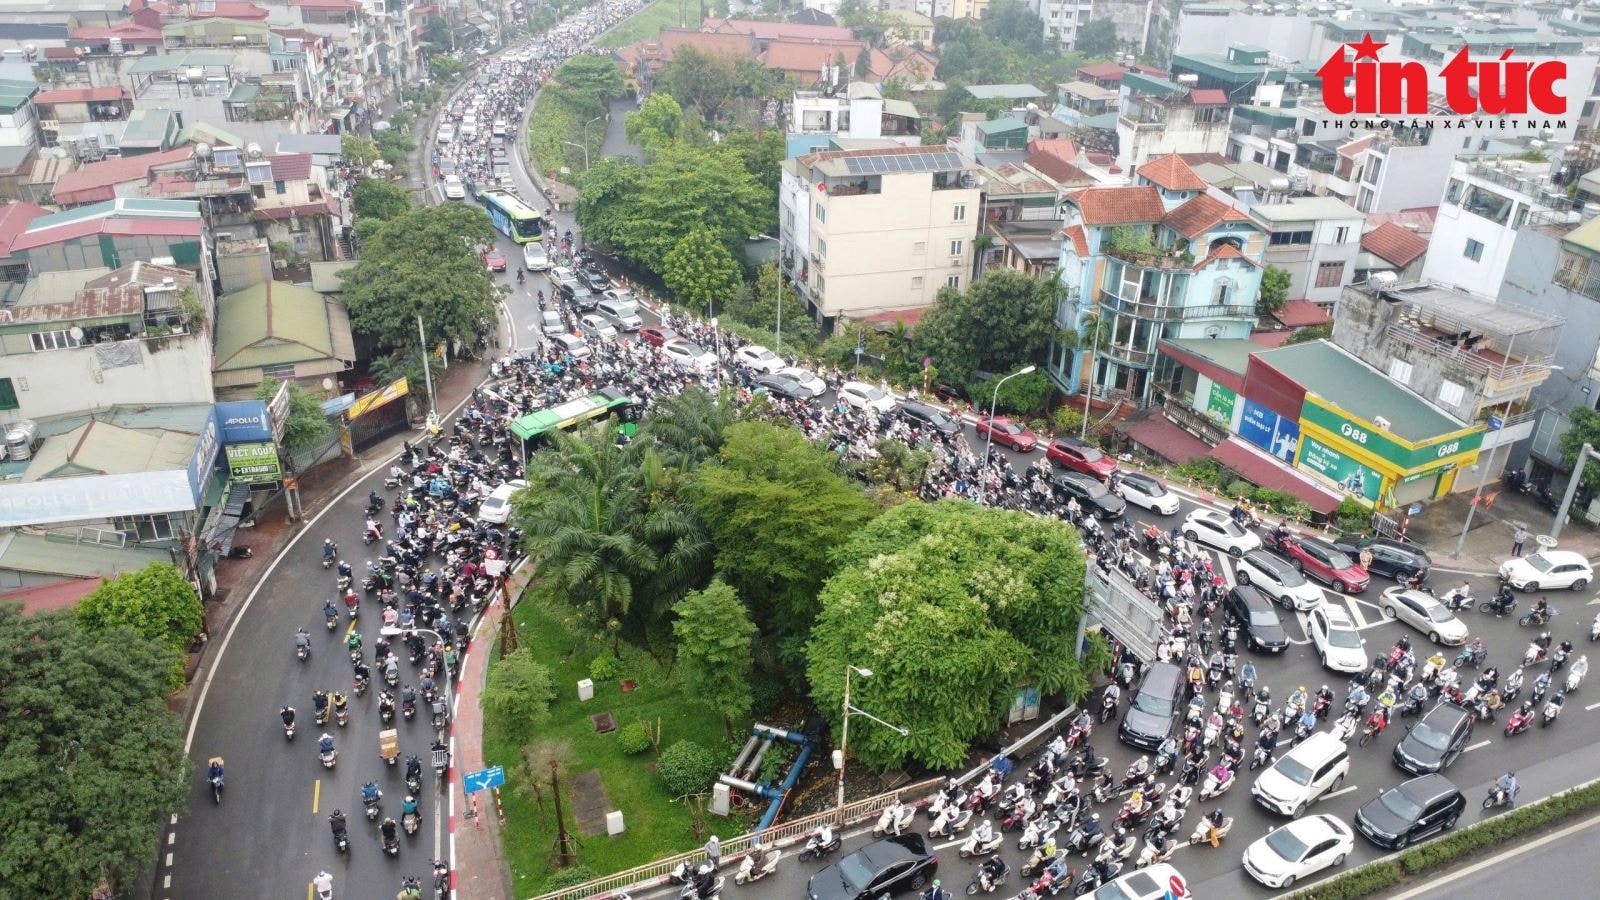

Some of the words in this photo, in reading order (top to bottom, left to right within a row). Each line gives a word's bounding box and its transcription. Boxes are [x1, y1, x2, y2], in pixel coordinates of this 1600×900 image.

[225, 416, 259, 425] APOLLO
[1341, 423, 1367, 444] F88
[1437, 442, 1460, 458] F88
